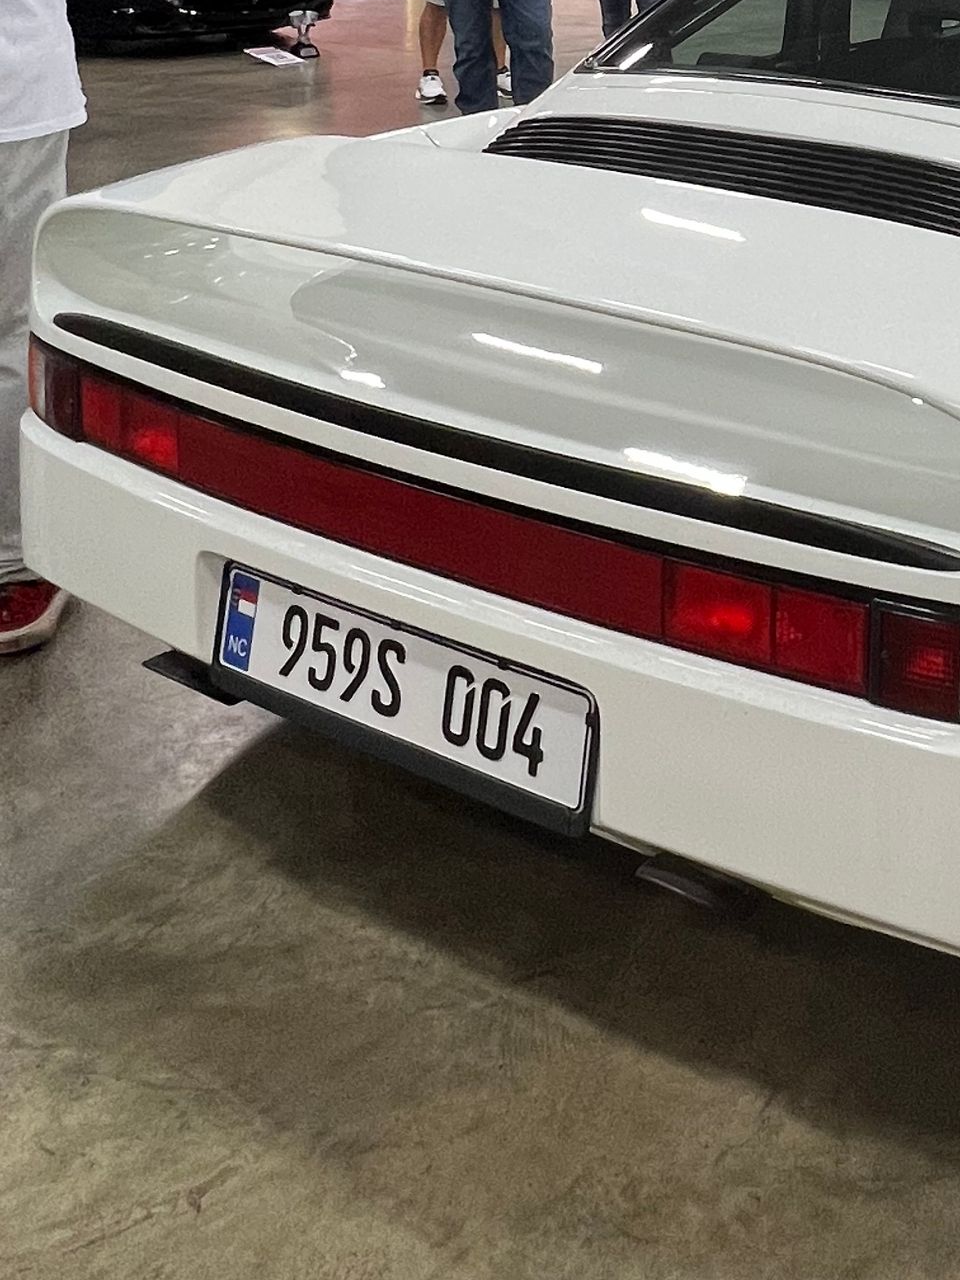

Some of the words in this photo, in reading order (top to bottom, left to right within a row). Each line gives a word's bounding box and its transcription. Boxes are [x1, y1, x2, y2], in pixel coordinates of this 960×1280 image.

[228, 634, 248, 657] NC
[279, 605, 406, 717] 959S
[442, 665, 543, 777] 004
